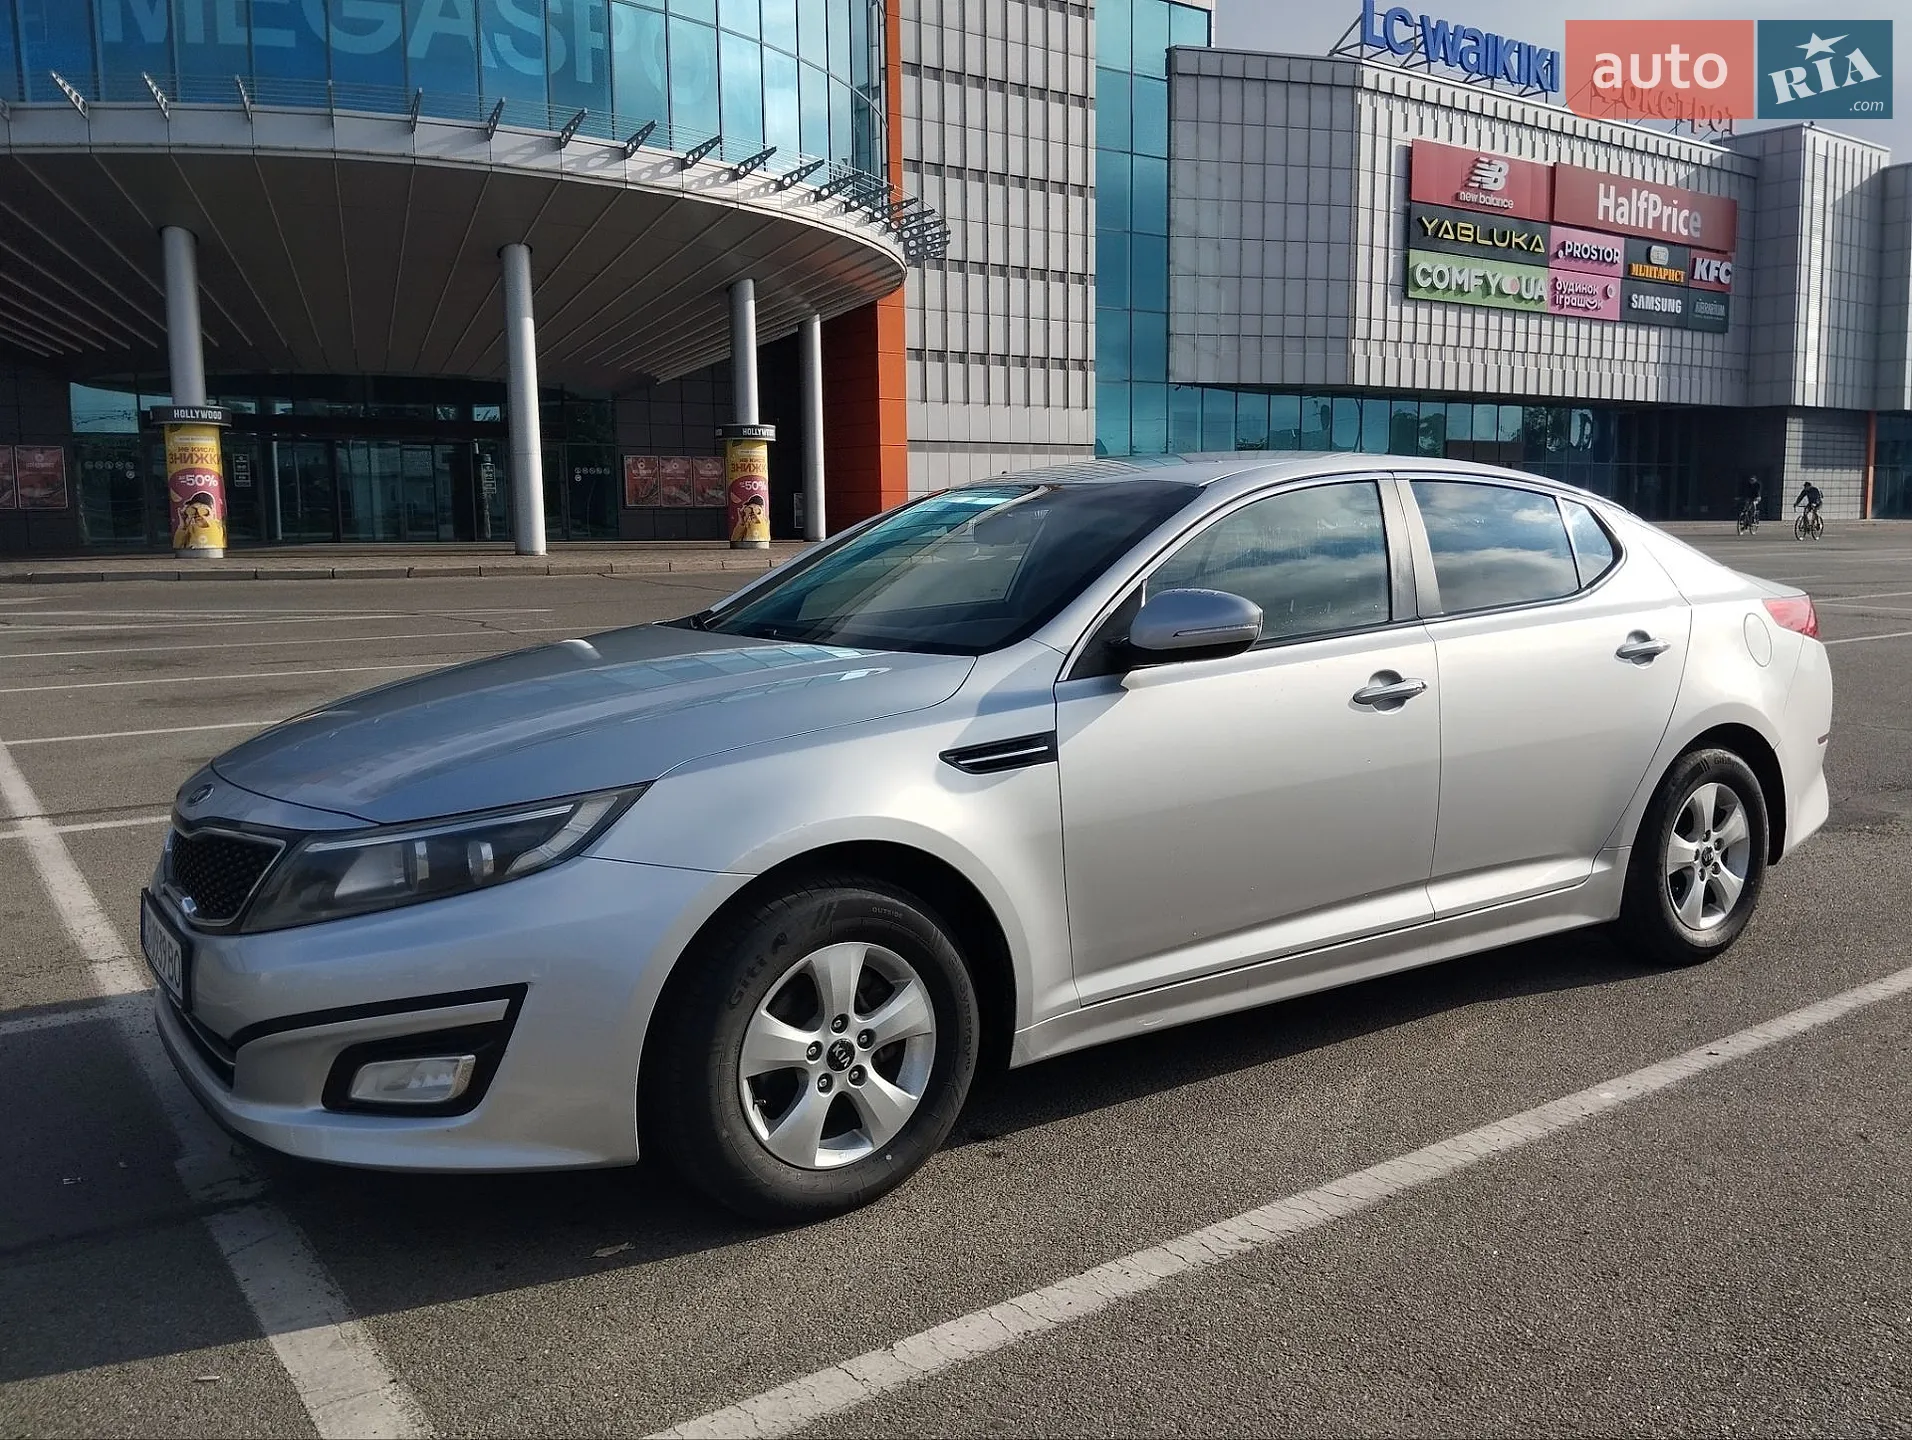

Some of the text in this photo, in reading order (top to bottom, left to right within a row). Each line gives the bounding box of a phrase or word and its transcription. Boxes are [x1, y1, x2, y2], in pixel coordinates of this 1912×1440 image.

[1363, 0, 1415, 55] LC
[1459, 191, 1514, 209] new balance
[1597, 183, 1702, 238] HalfPrice
[1421, 216, 1546, 253] YABLUKA
[1693, 257, 1732, 285] KFC
[1631, 293, 1682, 314] SAMSUNG
[173, 408, 222, 420] HOLLYWOOD
[831, 1043, 852, 1069] KIA
